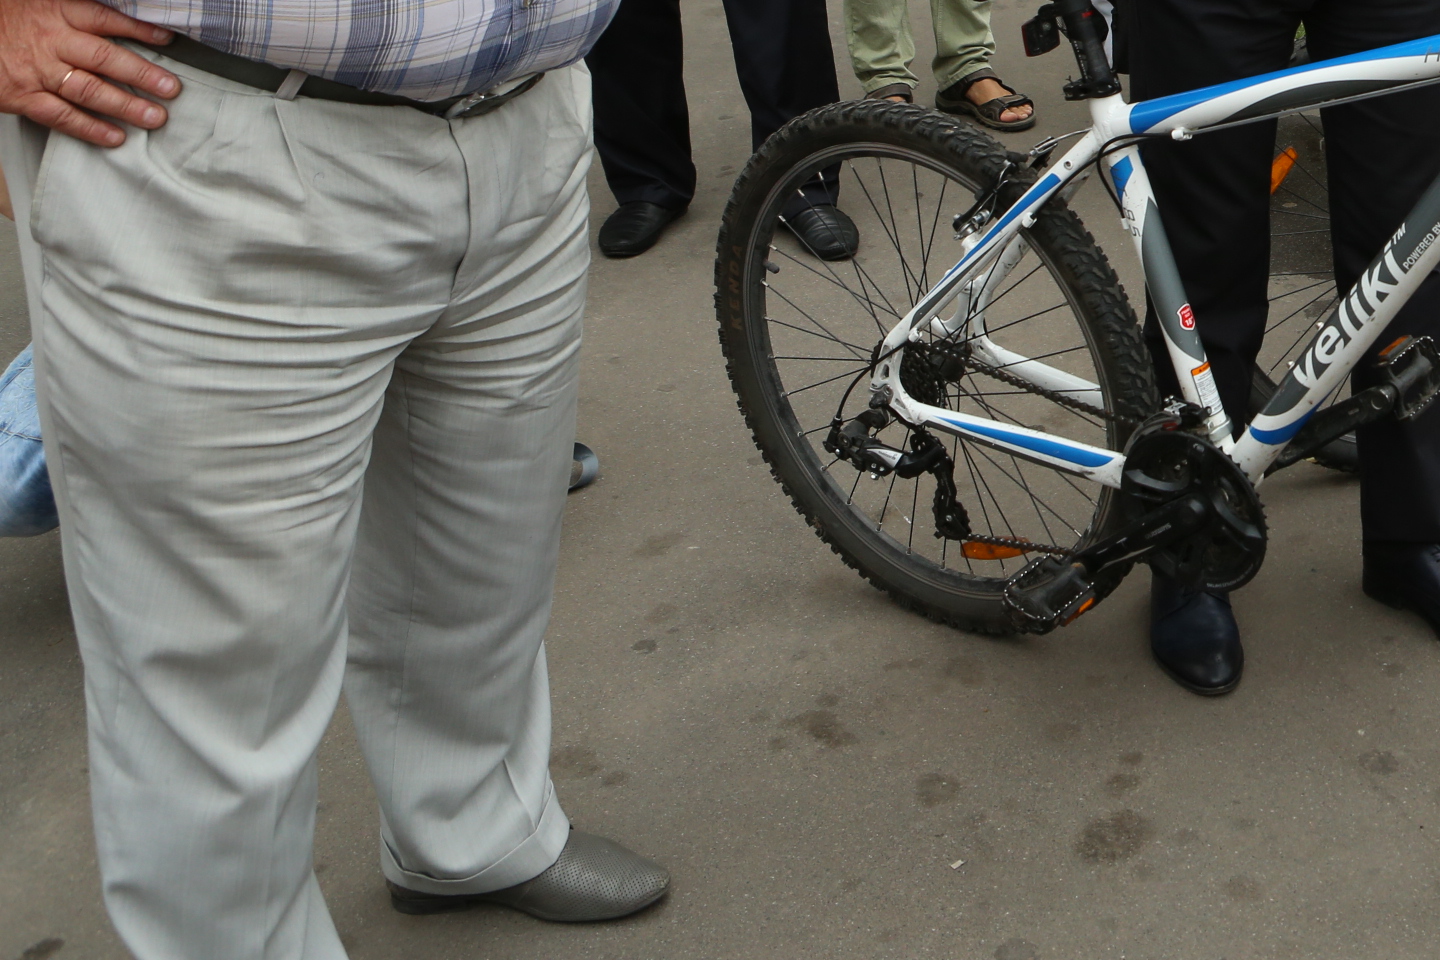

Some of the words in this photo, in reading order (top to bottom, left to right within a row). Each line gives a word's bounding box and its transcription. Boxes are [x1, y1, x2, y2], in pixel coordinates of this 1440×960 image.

[1402, 233, 1436, 271] POWERED
[1293, 240, 1407, 389] veliki
[1391, 222, 1407, 246] TM
